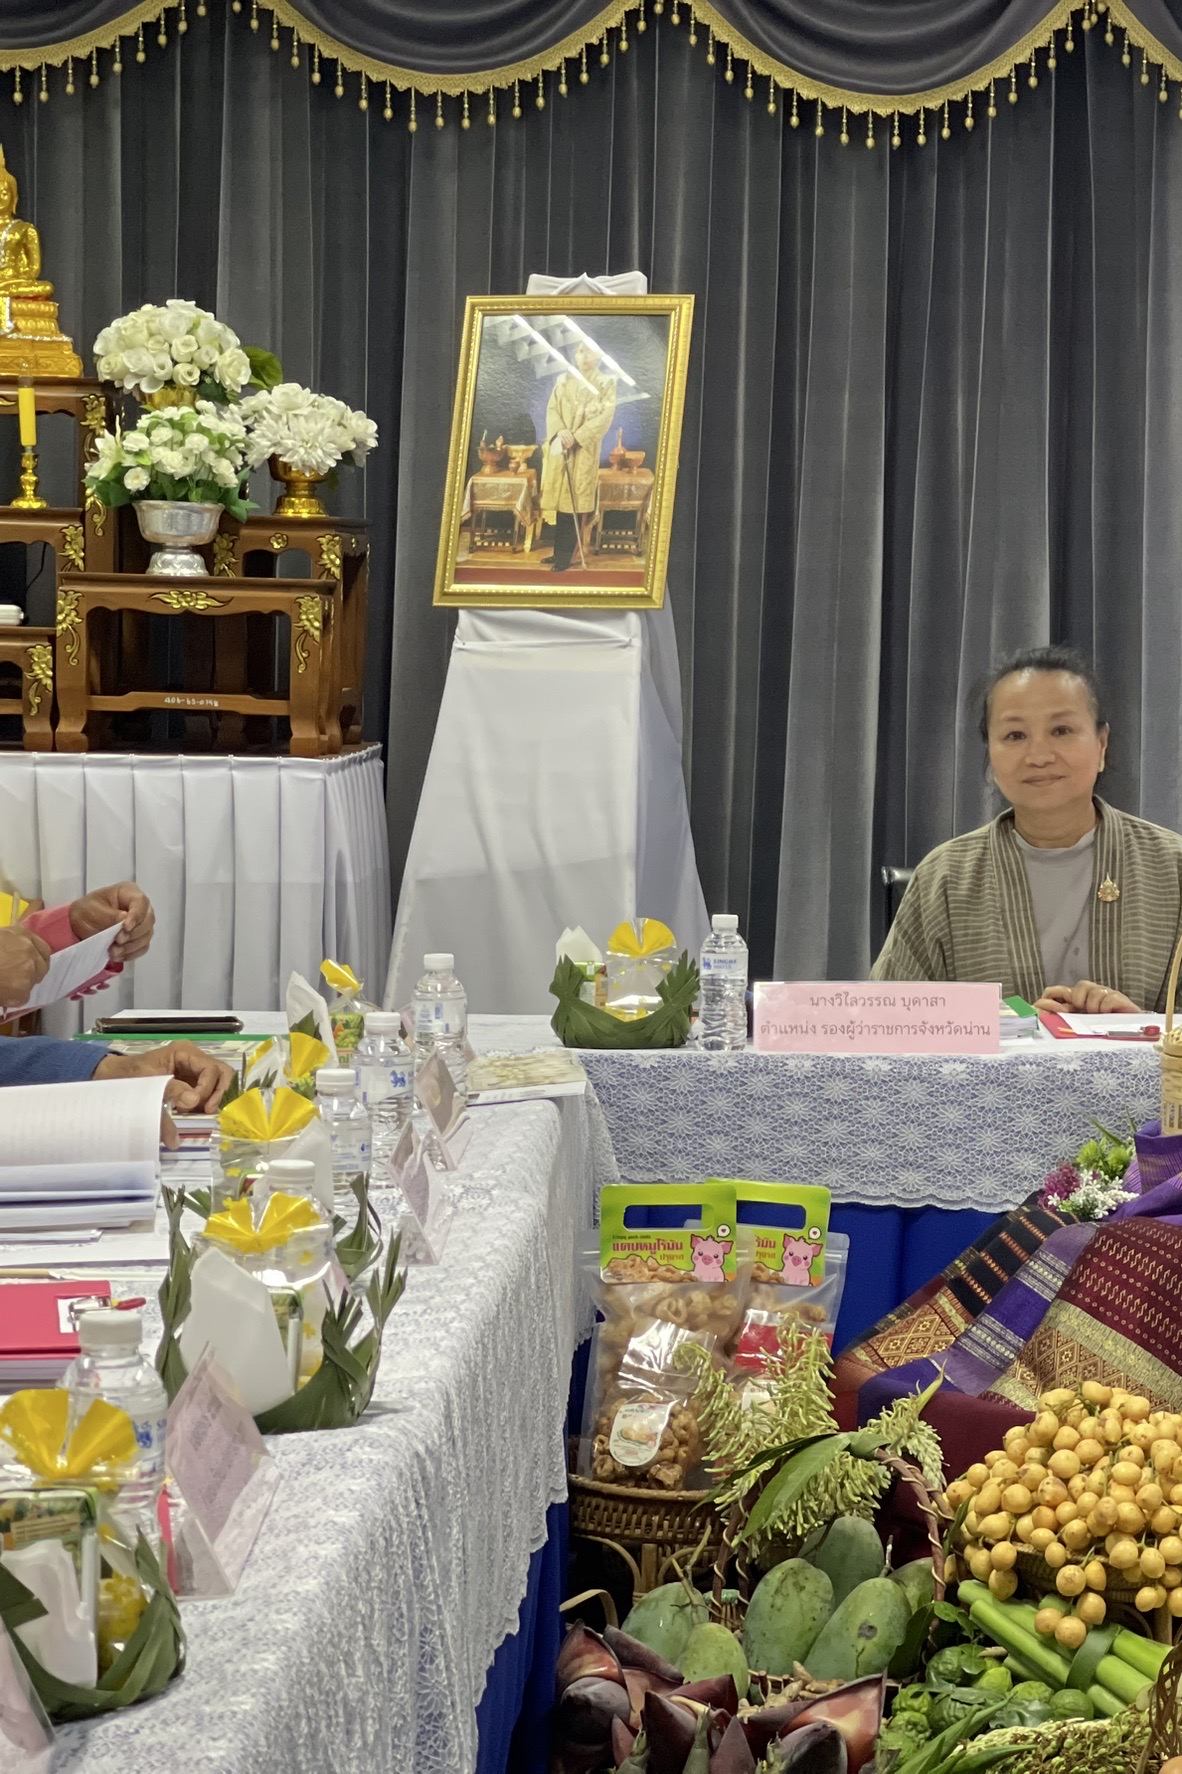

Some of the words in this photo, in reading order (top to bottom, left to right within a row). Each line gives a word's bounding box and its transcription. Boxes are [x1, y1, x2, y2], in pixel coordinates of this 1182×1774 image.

[809, 991, 896, 1007] นางวิไลวรรณ
[760, 1020, 817, 1036] ตำแหน่ง
[820, 1019, 991, 1040] รองผู้ว่าราชการจังหวัดน่าน
